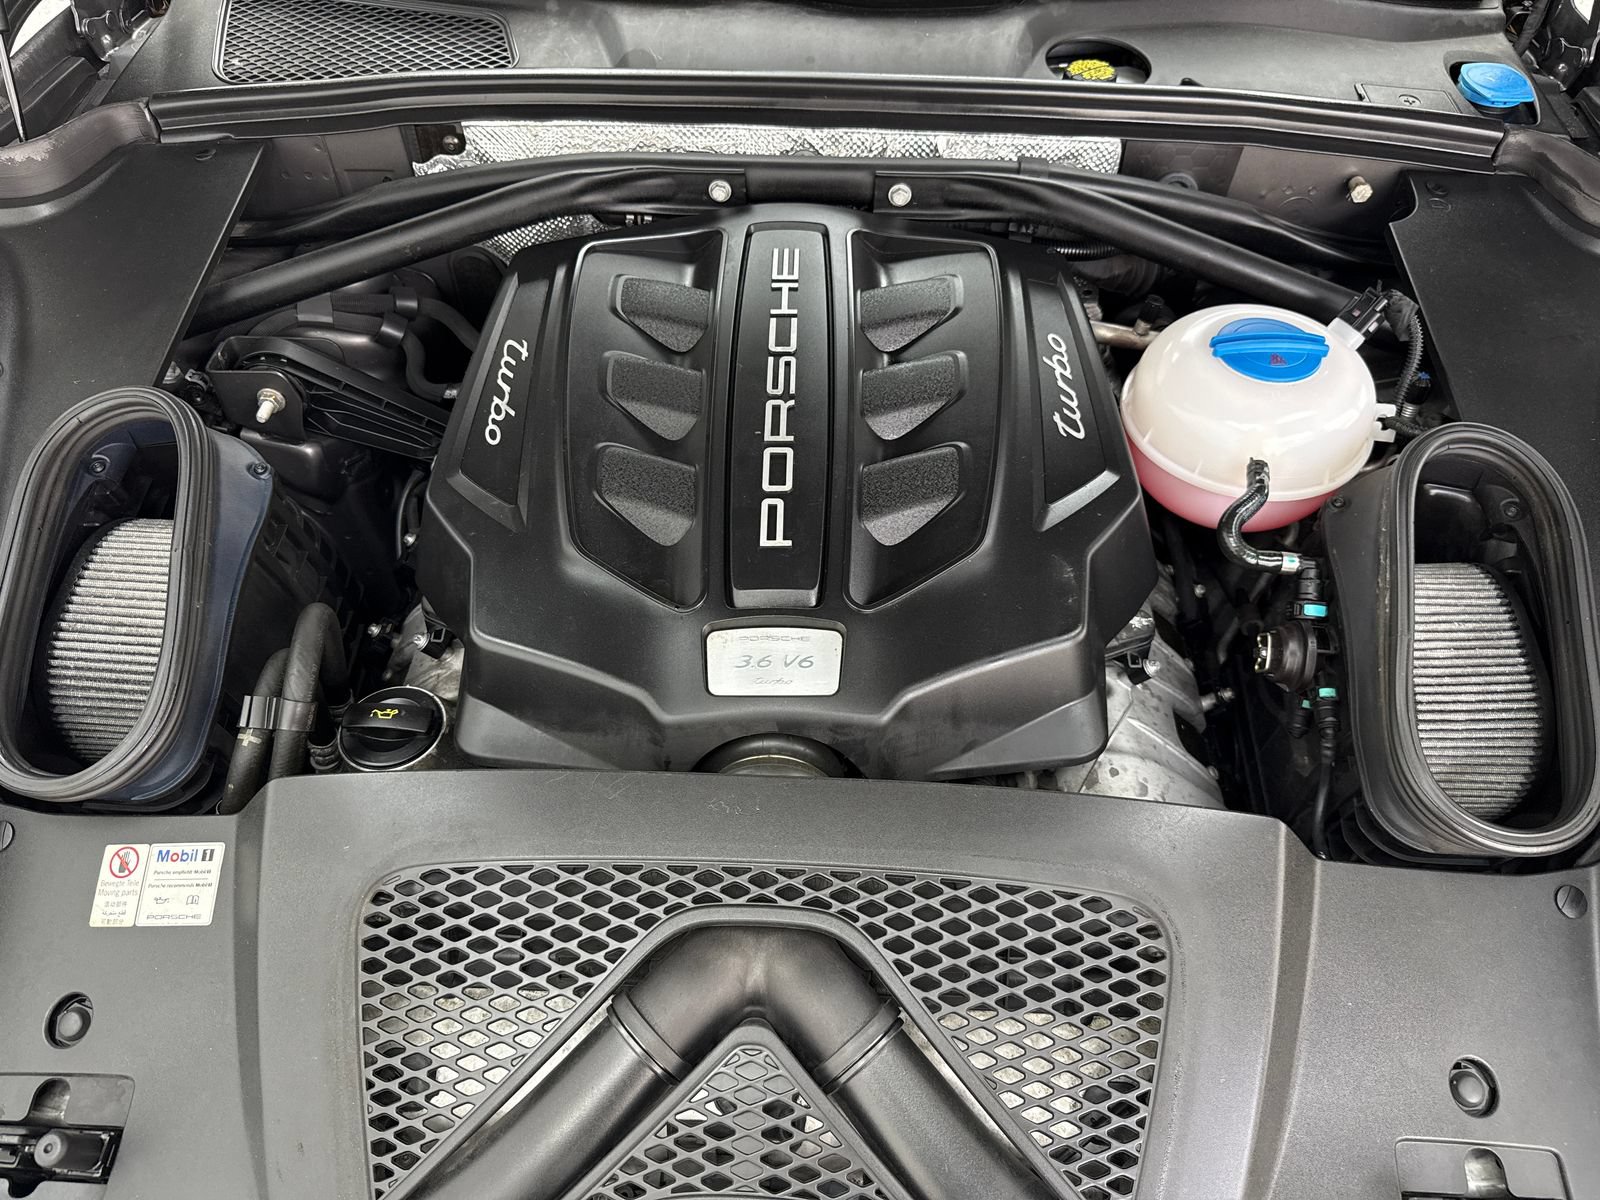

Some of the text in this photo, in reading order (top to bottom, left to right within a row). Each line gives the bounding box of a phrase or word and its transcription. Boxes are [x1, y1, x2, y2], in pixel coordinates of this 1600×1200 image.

[484, 339, 529, 445] turbo
[759, 247, 800, 547] PORSCHE
[1042, 333, 1085, 440] turbo
[735, 654, 815, 669] 3.6 V6
[157, 849, 215, 862] Mobil 1
[97, 888, 138, 898] Moving parts
